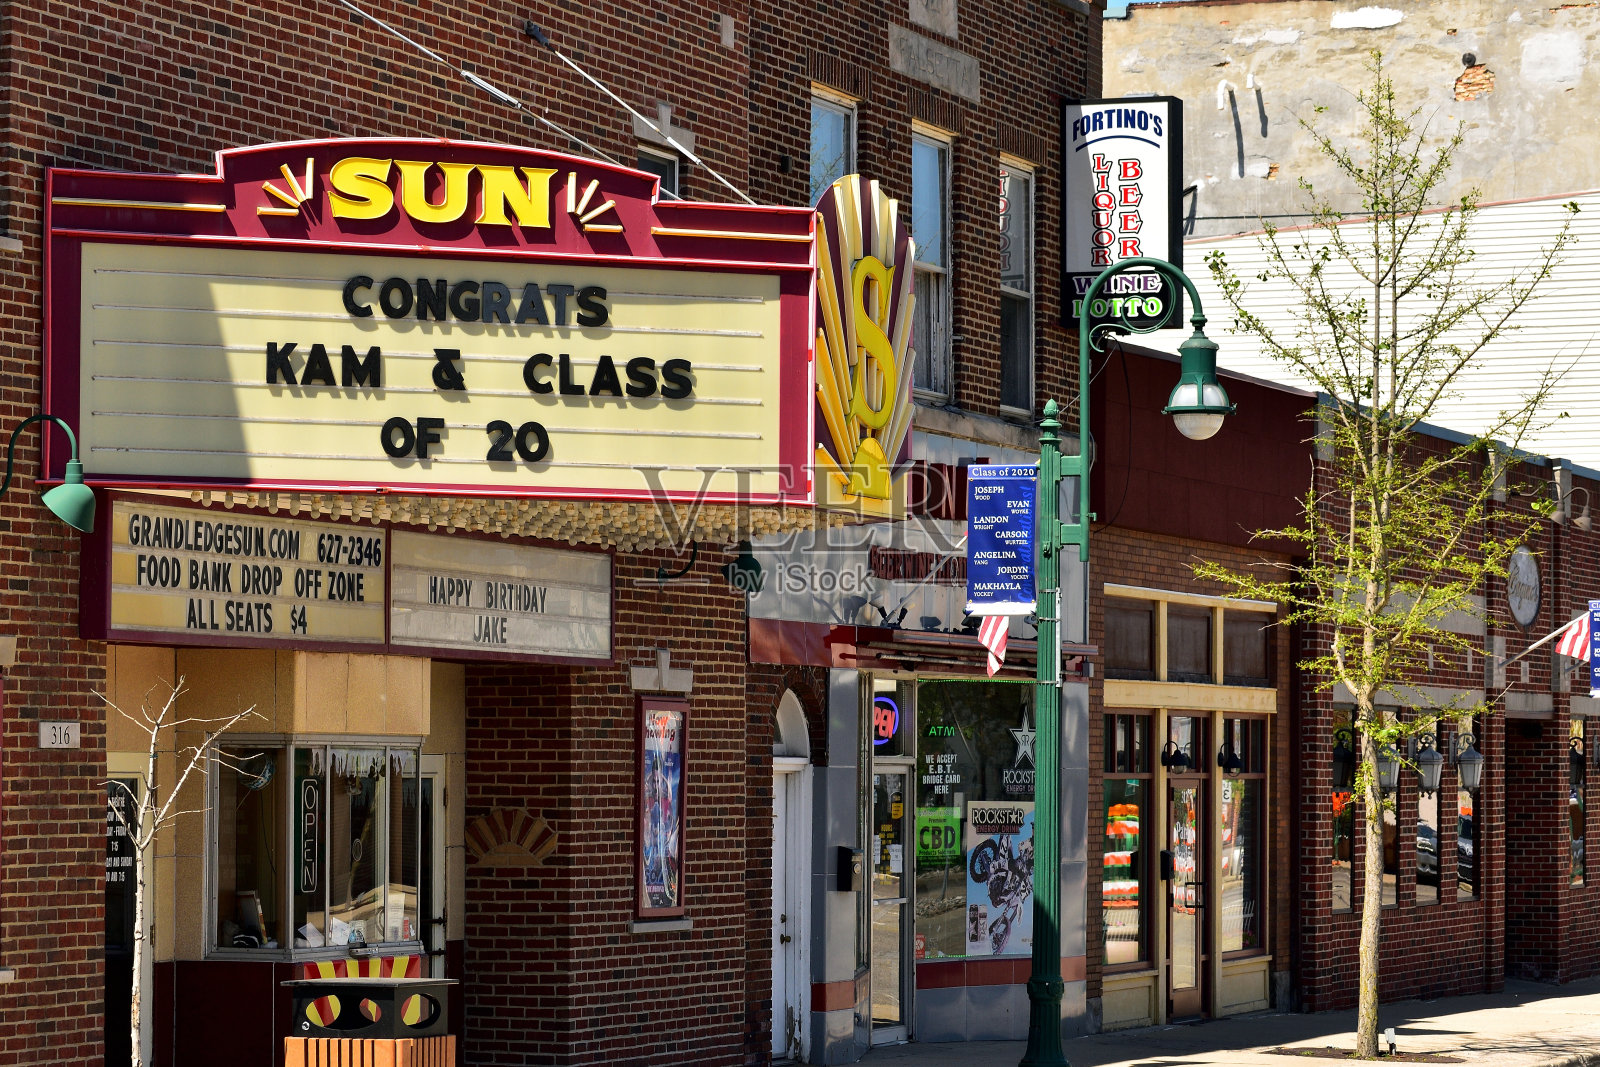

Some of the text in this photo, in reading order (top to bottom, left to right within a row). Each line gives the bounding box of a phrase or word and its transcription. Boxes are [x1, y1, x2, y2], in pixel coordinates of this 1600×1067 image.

[1073, 109, 1163, 142] FORTINO'S
[327, 156, 559, 228] SUN
[1092, 153, 1117, 267] LIQUOR
[1118, 158, 1143, 259] BEER
[1073, 274, 1162, 294] WINE
[342, 275, 609, 328] CONGRATS
[265, 341, 693, 399] KAM & CLASS
[381, 416, 550, 463] OF 20
[971, 467, 1034, 476] Class of 2020
[974, 486, 1004, 495] JOSEPH
[129, 513, 381, 567] GRANDLEDGESUN.COM 627-2346
[137, 554, 364, 602] FOOD BANK DROP OFF ZONE
[997, 566, 1029, 575] JORDYN
[429, 575, 547, 613] HAPPY BIRTHDAY
[186, 598, 307, 635] ALL SEATS $4
[474, 615, 508, 643] JAKE
[51, 725, 70, 744] 316
[645, 726, 677, 742] howing
[874, 706, 896, 739] PEN
[928, 726, 955, 737] ATM
[925, 754, 957, 764] WE ACCEPT
[929, 764, 954, 774] E.B.T.
[922, 775, 960, 785] BRIDGE CARD
[934, 785, 949, 795] HERE
[304, 785, 316, 886] OPEN
[919, 826, 956, 850] CBD
[976, 825, 1000, 833] ENERGY
